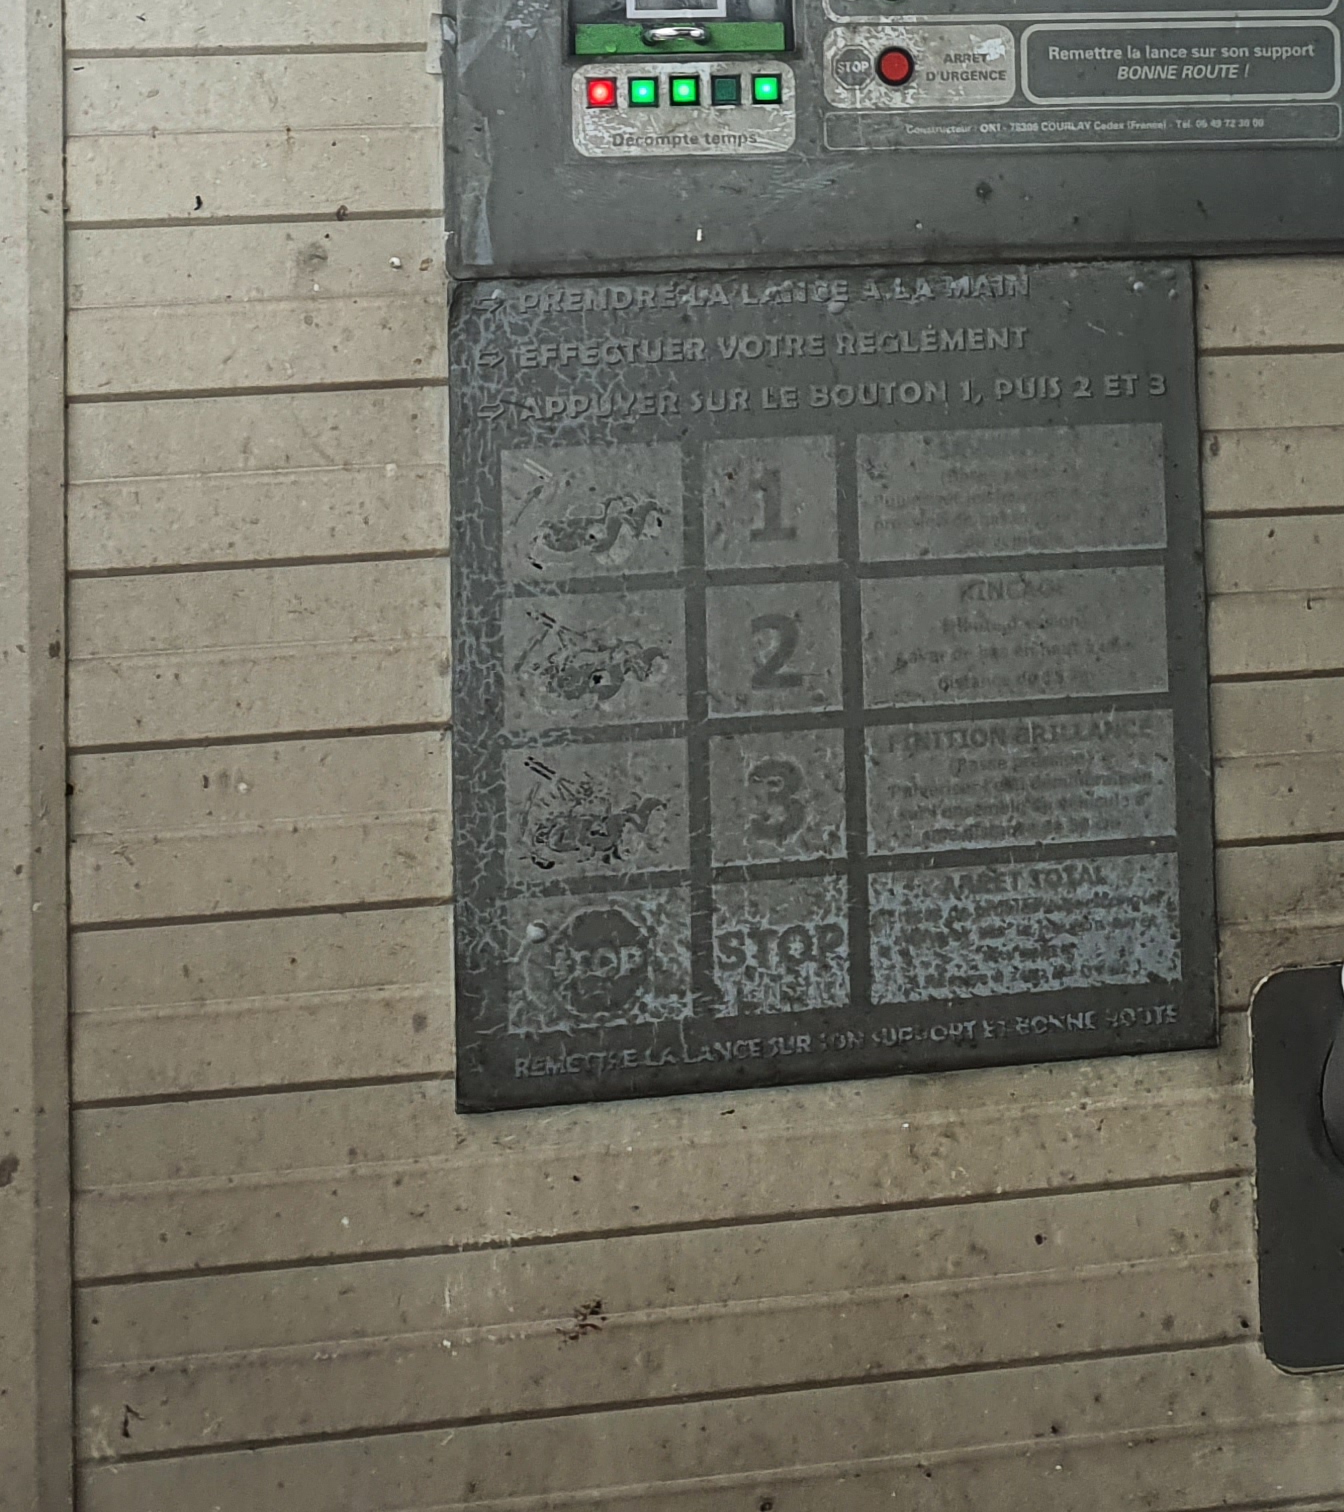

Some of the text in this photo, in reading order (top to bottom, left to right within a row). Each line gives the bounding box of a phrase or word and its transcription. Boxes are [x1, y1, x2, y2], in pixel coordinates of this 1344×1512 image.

[837, 60, 870, 74] STOP
[1048, 44, 1315, 61] Remettre la lance sur son support
[926, 69, 1007, 83] D'URGENCE
[1117, 65, 1177, 81] BONNE
[1181, 64, 1239, 80] ROUTE
[612, 132, 757, 149] Décompte temps
[519, 285, 676, 314] PRENDRE
[687, 283, 730, 308] LA
[740, 279, 849, 307] LANCE
[940, 274, 1031, 300] MAIN
[519, 337, 708, 369] EFFECTUER
[718, 334, 826, 361] VOTRE
[520, 373, 1167, 421] APPUYER SUR LE BOUTON 1, PUIS 2 ET 3
[749, 466, 798, 542] 1
[752, 613, 804, 690] 2
[747, 757, 805, 845] 3
[714, 922, 846, 976] STOP
[683, 1038, 761, 1063] LANCE
[767, 1034, 812, 1057] SUR
